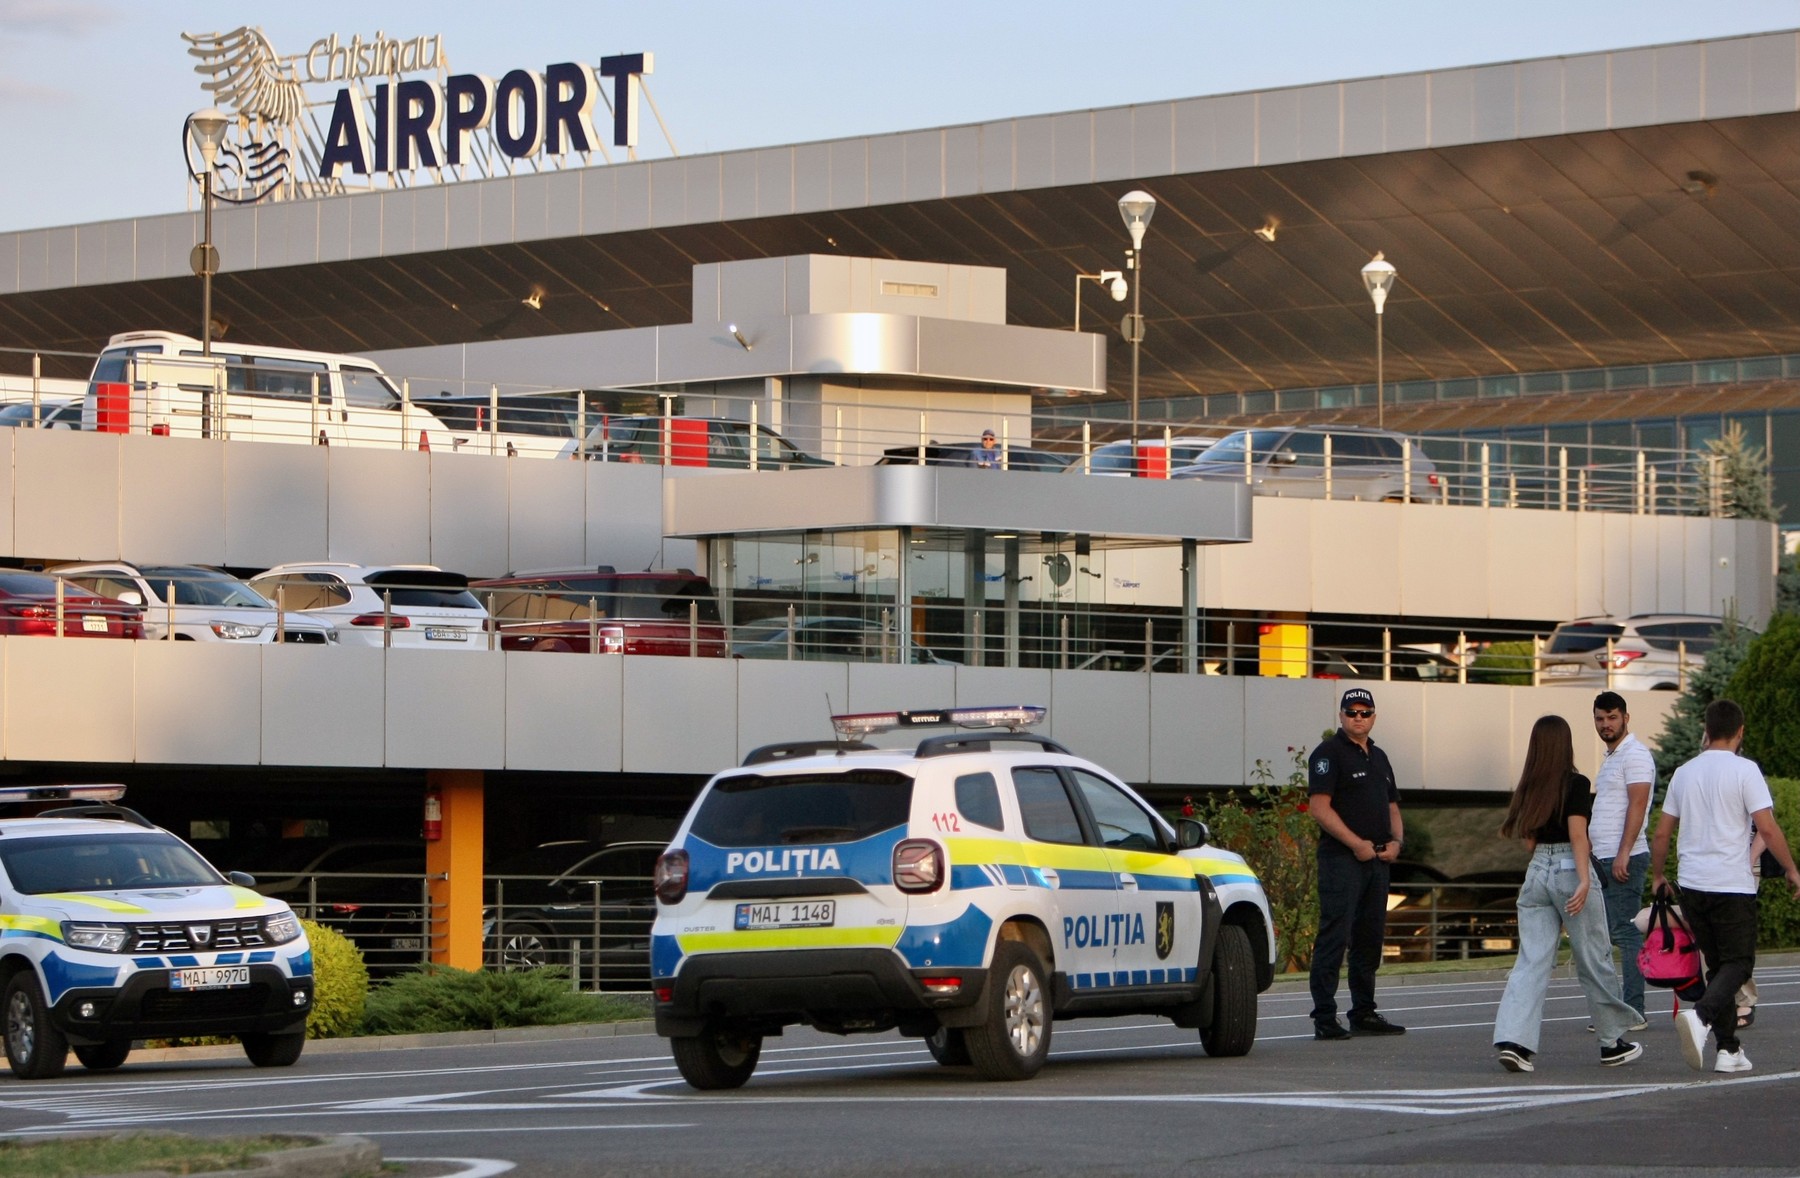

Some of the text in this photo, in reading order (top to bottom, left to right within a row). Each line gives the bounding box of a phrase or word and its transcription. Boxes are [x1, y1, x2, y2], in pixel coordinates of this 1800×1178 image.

[306, 30, 442, 83] Chisinau
[318, 51, 654, 179] AIRPORT
[932, 812, 961, 832] 112
[726, 848, 841, 878] POLIȚIA
[751, 904, 830, 924] MAI 1148
[1063, 913, 1146, 959] POLIȚIA
[183, 968, 248, 986] MAI 9970
